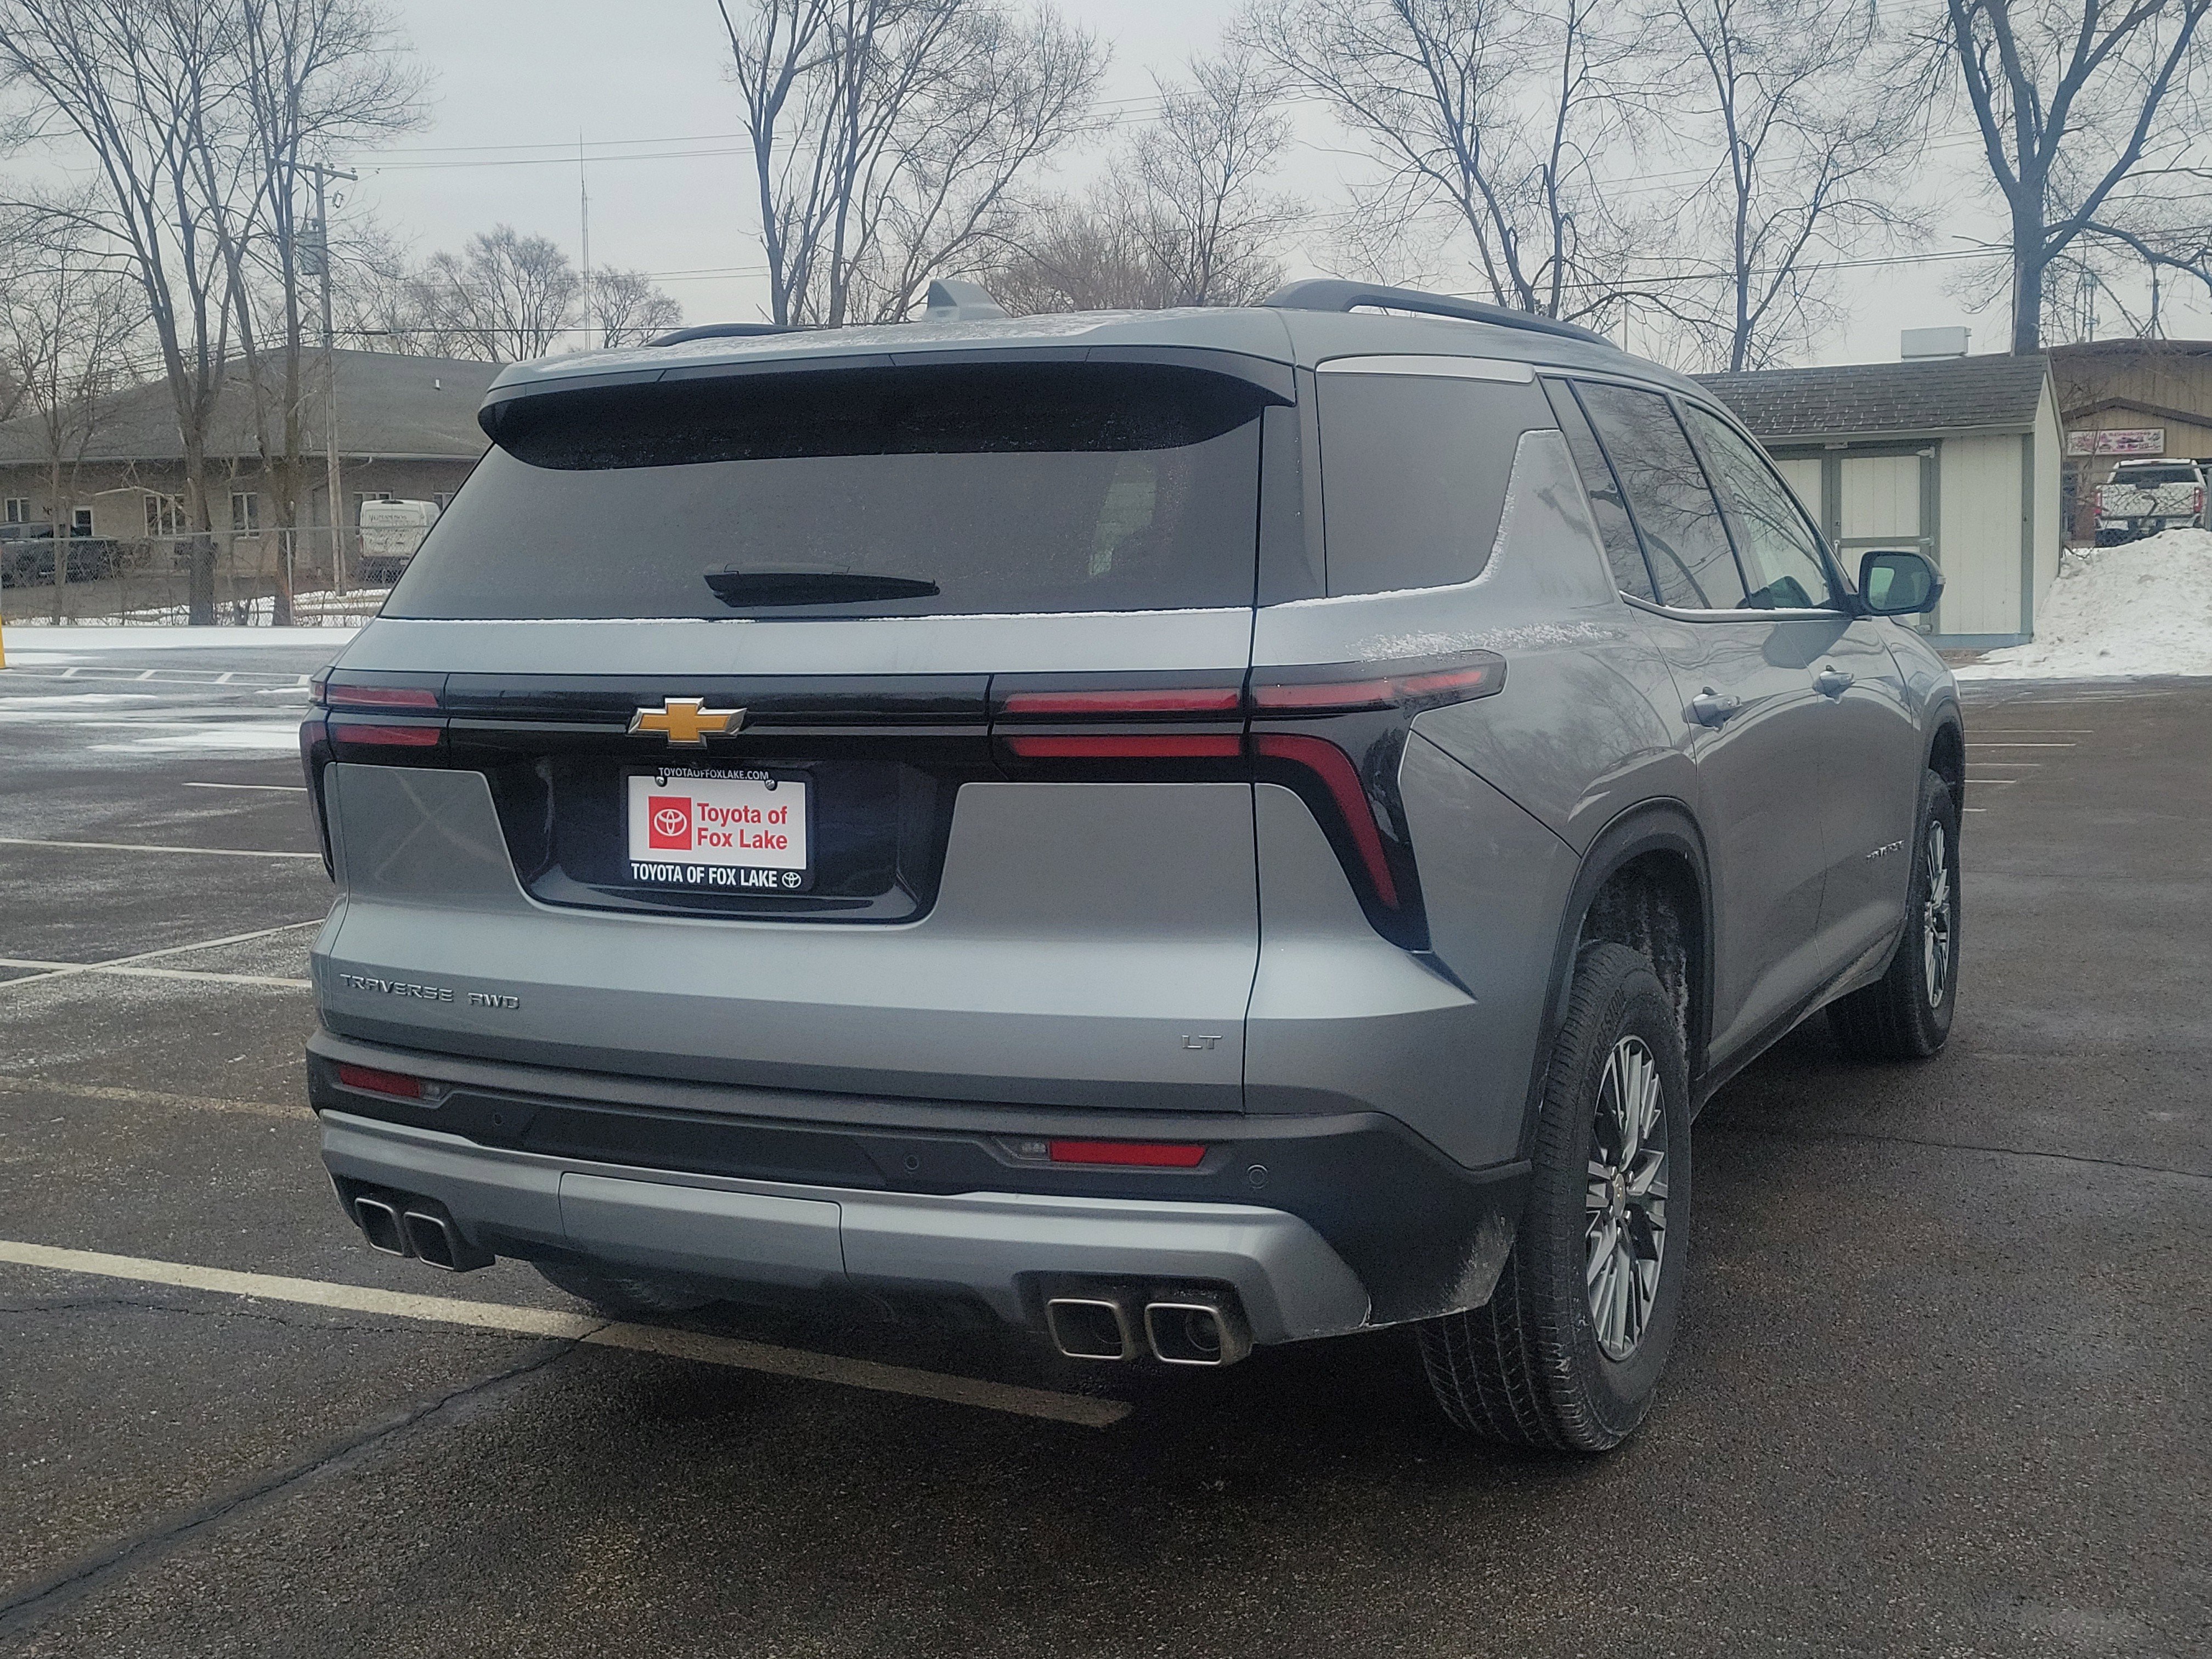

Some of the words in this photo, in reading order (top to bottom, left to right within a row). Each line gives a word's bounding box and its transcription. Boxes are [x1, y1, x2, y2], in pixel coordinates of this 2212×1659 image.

[658, 768, 769, 780] TOYOTAOFFOXLAKE.COM
[697, 803, 761, 827] Toyota
[768, 806, 788, 824] of
[697, 827, 733, 848] Fox
[740, 829, 788, 850] Lake
[631, 863, 683, 883] TOYOTA
[687, 866, 705, 884] OF
[709, 867, 736, 885] FOX
[740, 870, 778, 888] LAKE
[340, 974, 454, 1002] TRAVERSE
[467, 992, 521, 1010] AWD
[1182, 1035, 1223, 1049] LT
